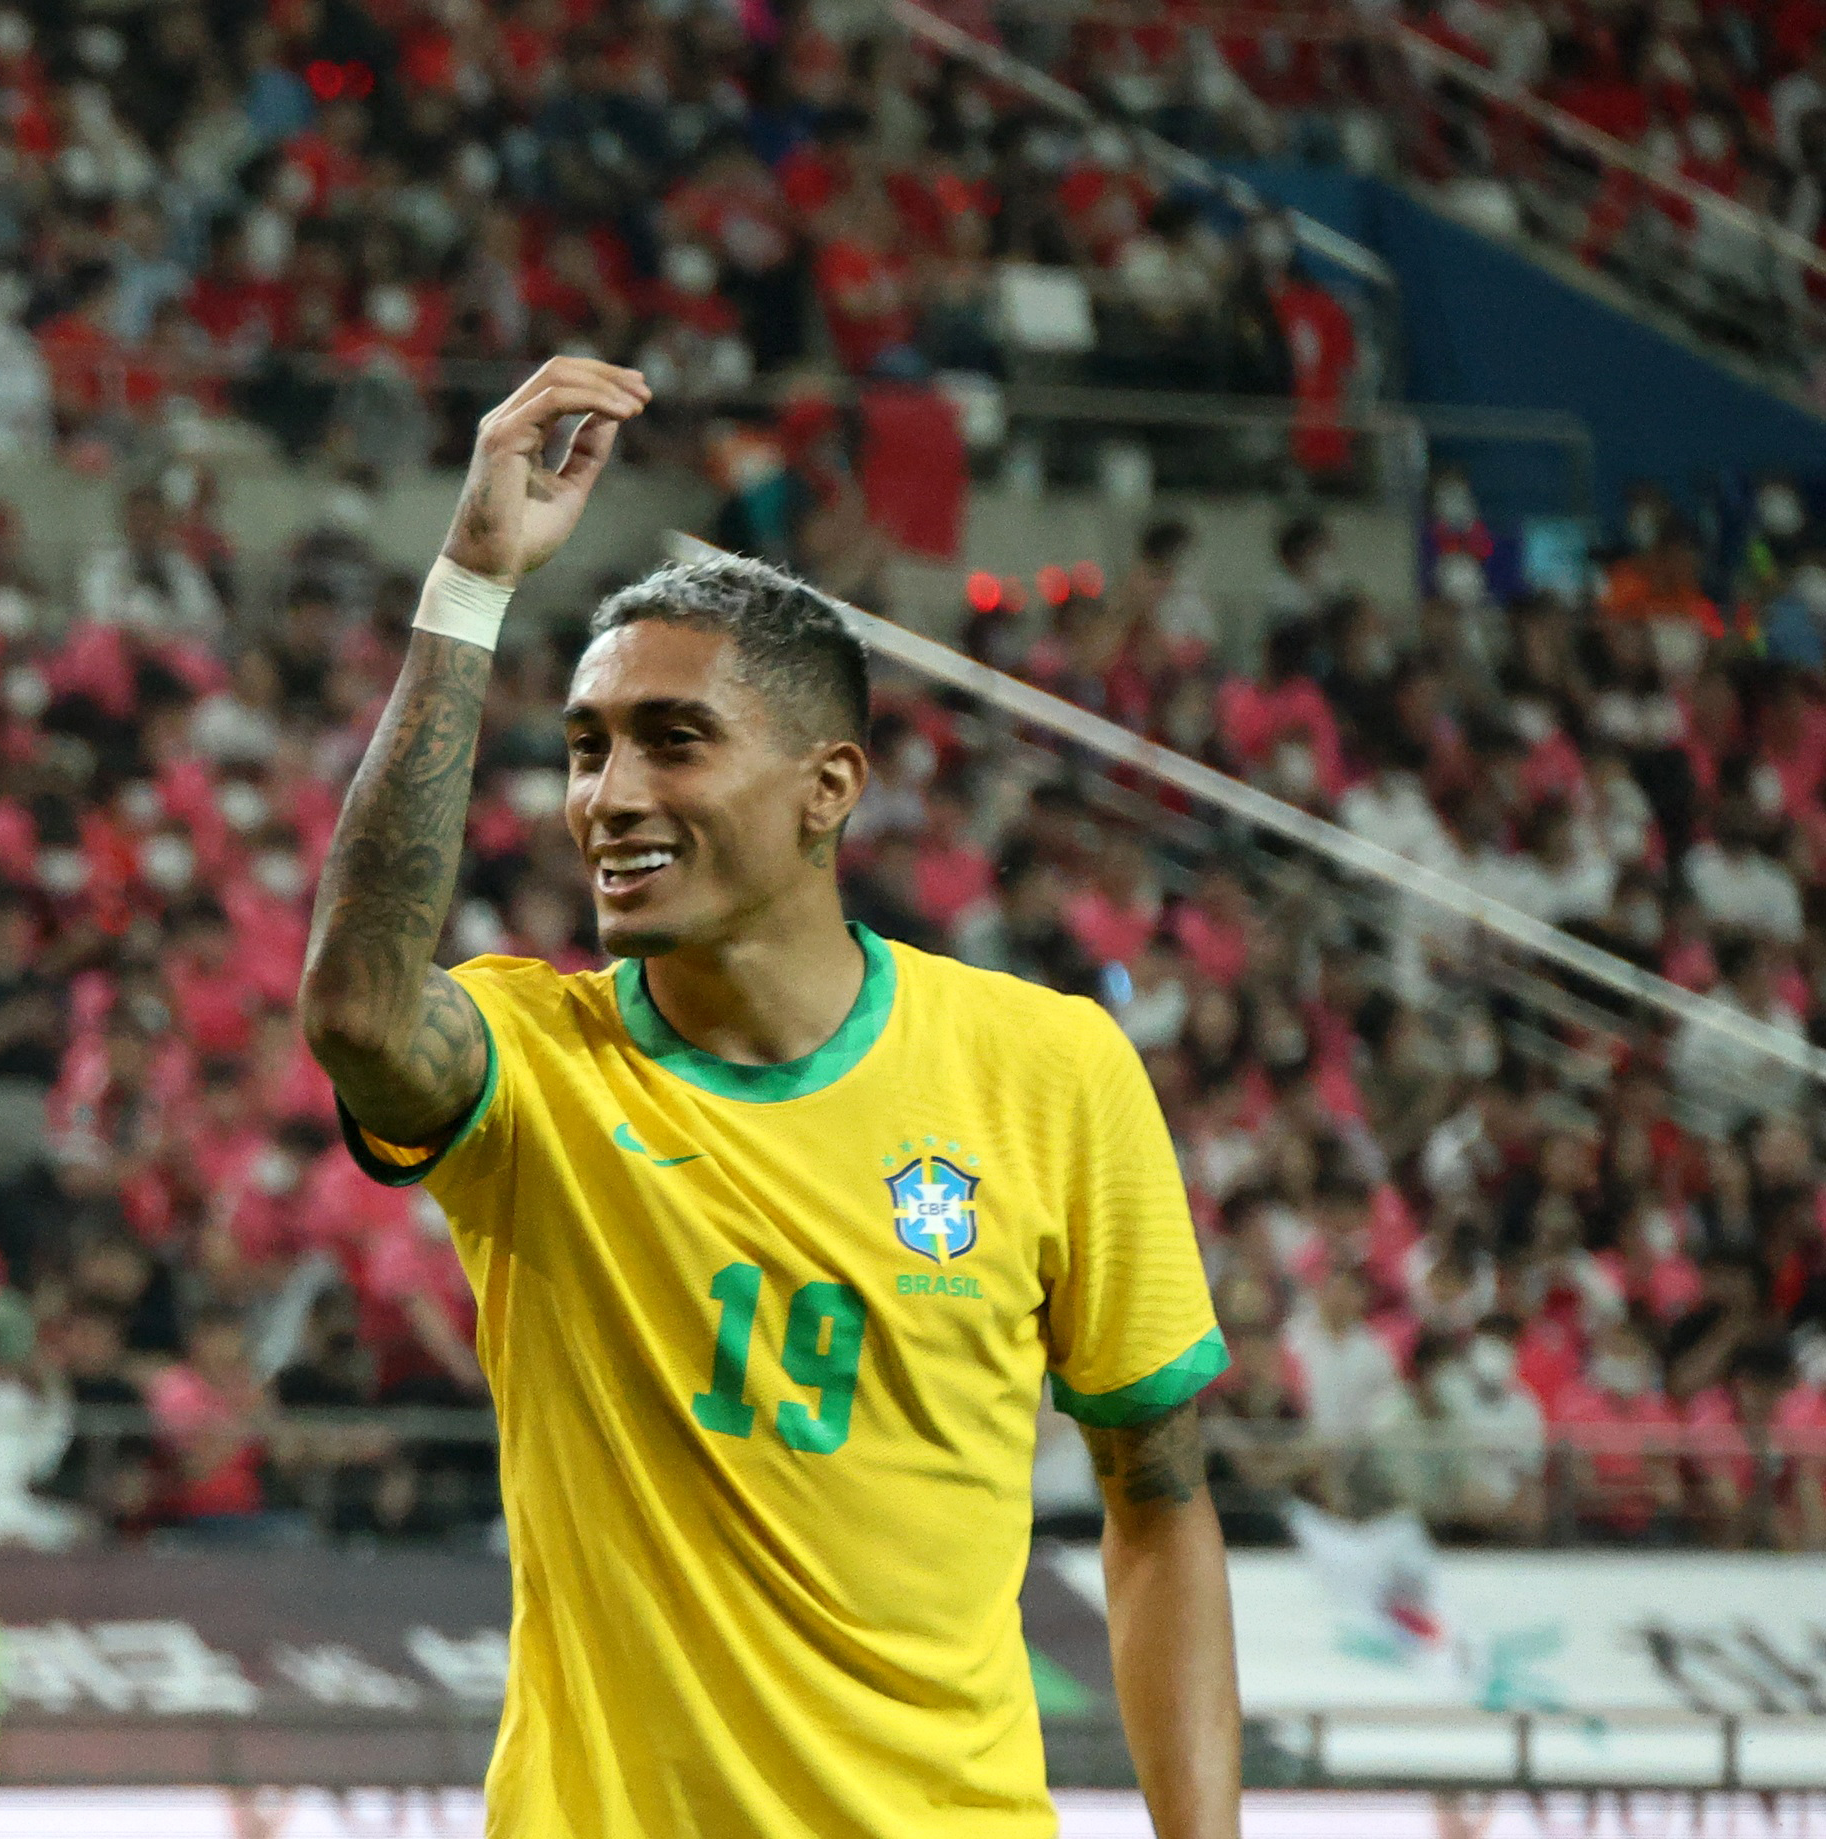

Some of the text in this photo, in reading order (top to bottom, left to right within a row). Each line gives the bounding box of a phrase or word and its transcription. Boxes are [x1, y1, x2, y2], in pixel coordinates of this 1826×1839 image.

[917, 1202, 950, 1216] CBF
[896, 1273, 984, 1299] BRASIL
[691, 1261, 868, 1455] 19
